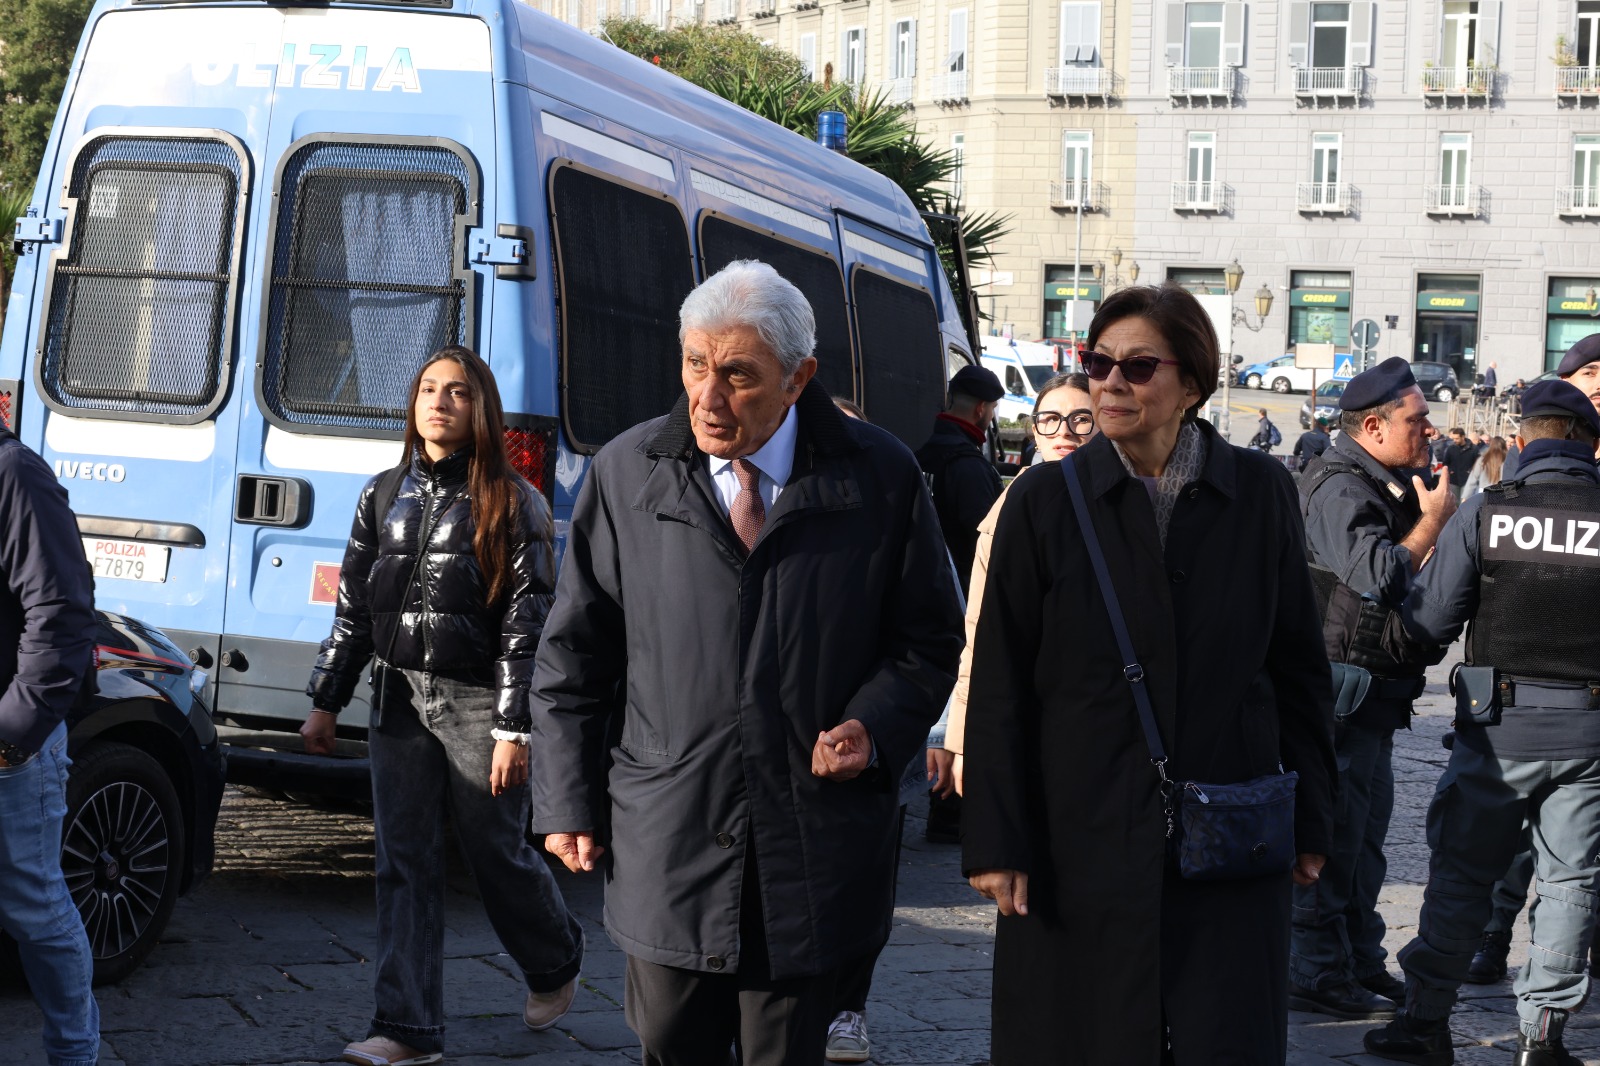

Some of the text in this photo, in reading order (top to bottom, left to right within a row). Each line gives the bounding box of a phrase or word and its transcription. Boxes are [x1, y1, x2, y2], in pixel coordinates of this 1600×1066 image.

[188, 43, 423, 93] OLIZIA
[1302, 294, 1337, 303] CREDEM
[1429, 297, 1466, 307] CREDEM
[55, 460, 127, 483] IVECO
[1489, 514, 1600, 557] POLIZ
[96, 541, 146, 558] POLIZIA
[93, 557, 144, 580] F7879
